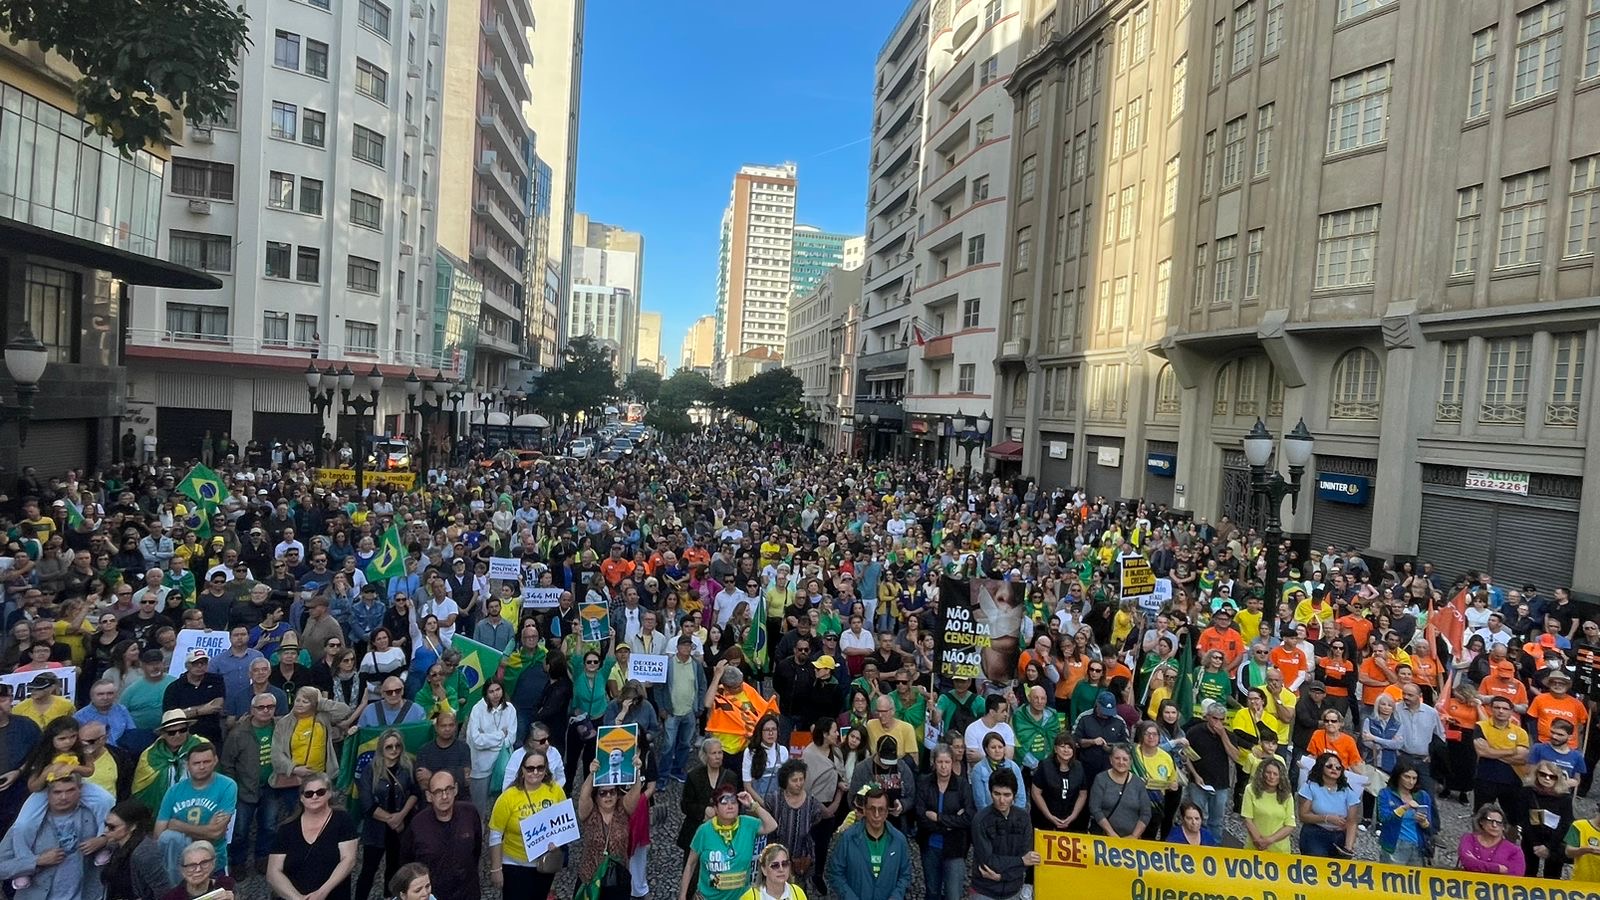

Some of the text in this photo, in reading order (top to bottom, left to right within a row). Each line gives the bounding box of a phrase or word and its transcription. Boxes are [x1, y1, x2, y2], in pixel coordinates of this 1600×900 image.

[1487, 471, 1528, 482] ALUGA
[1320, 481, 1348, 491] UNINTER
[1466, 479, 1527, 491] 3262-2261
[946, 605, 969, 620] NÃO
[945, 619, 991, 635] AO PL DA
[195, 636, 225, 648] REAGE
[944, 631, 992, 648] CENSURA
[942, 648, 982, 665] NÃO AO
[941, 662, 980, 677] PL 2630
[524, 813, 574, 841] 344 MIL
[527, 823, 575, 848] VOZES CALADAS
[709, 850, 721, 862] GO
[1043, 834, 1088, 862] TSE:
[1094, 839, 1195, 877] Respeite
[1203, 855, 1217, 875] o
[1224, 857, 1278, 881] voto
[1287, 859, 1317, 885] de
[1327, 861, 1374, 890] 344
[1382, 869, 1421, 894] mil
